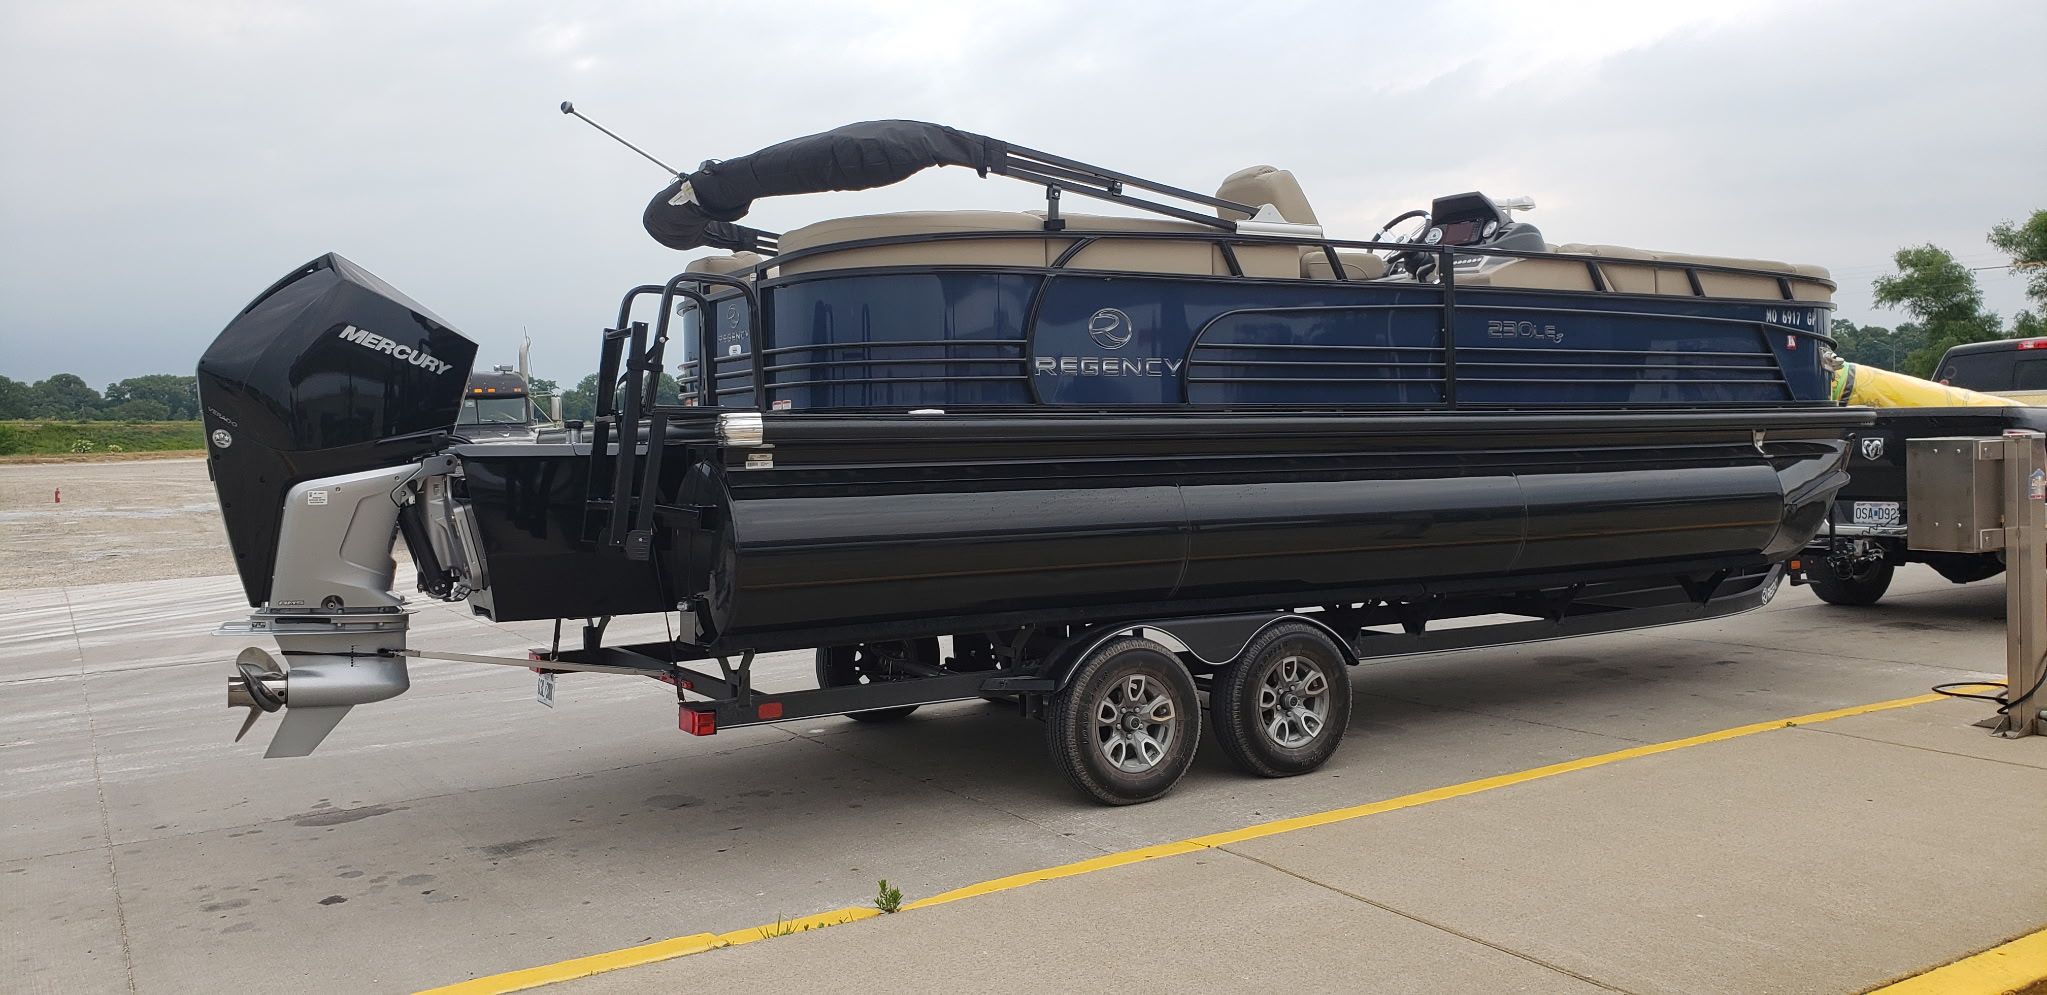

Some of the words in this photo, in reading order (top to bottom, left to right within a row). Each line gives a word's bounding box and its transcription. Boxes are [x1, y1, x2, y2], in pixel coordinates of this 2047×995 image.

[1765, 308, 1777, 323] MO
[1782, 310, 1801, 326] 6917
[338, 325, 453, 376] MERCURY
[1034, 356, 1184, 377] REGENCY
